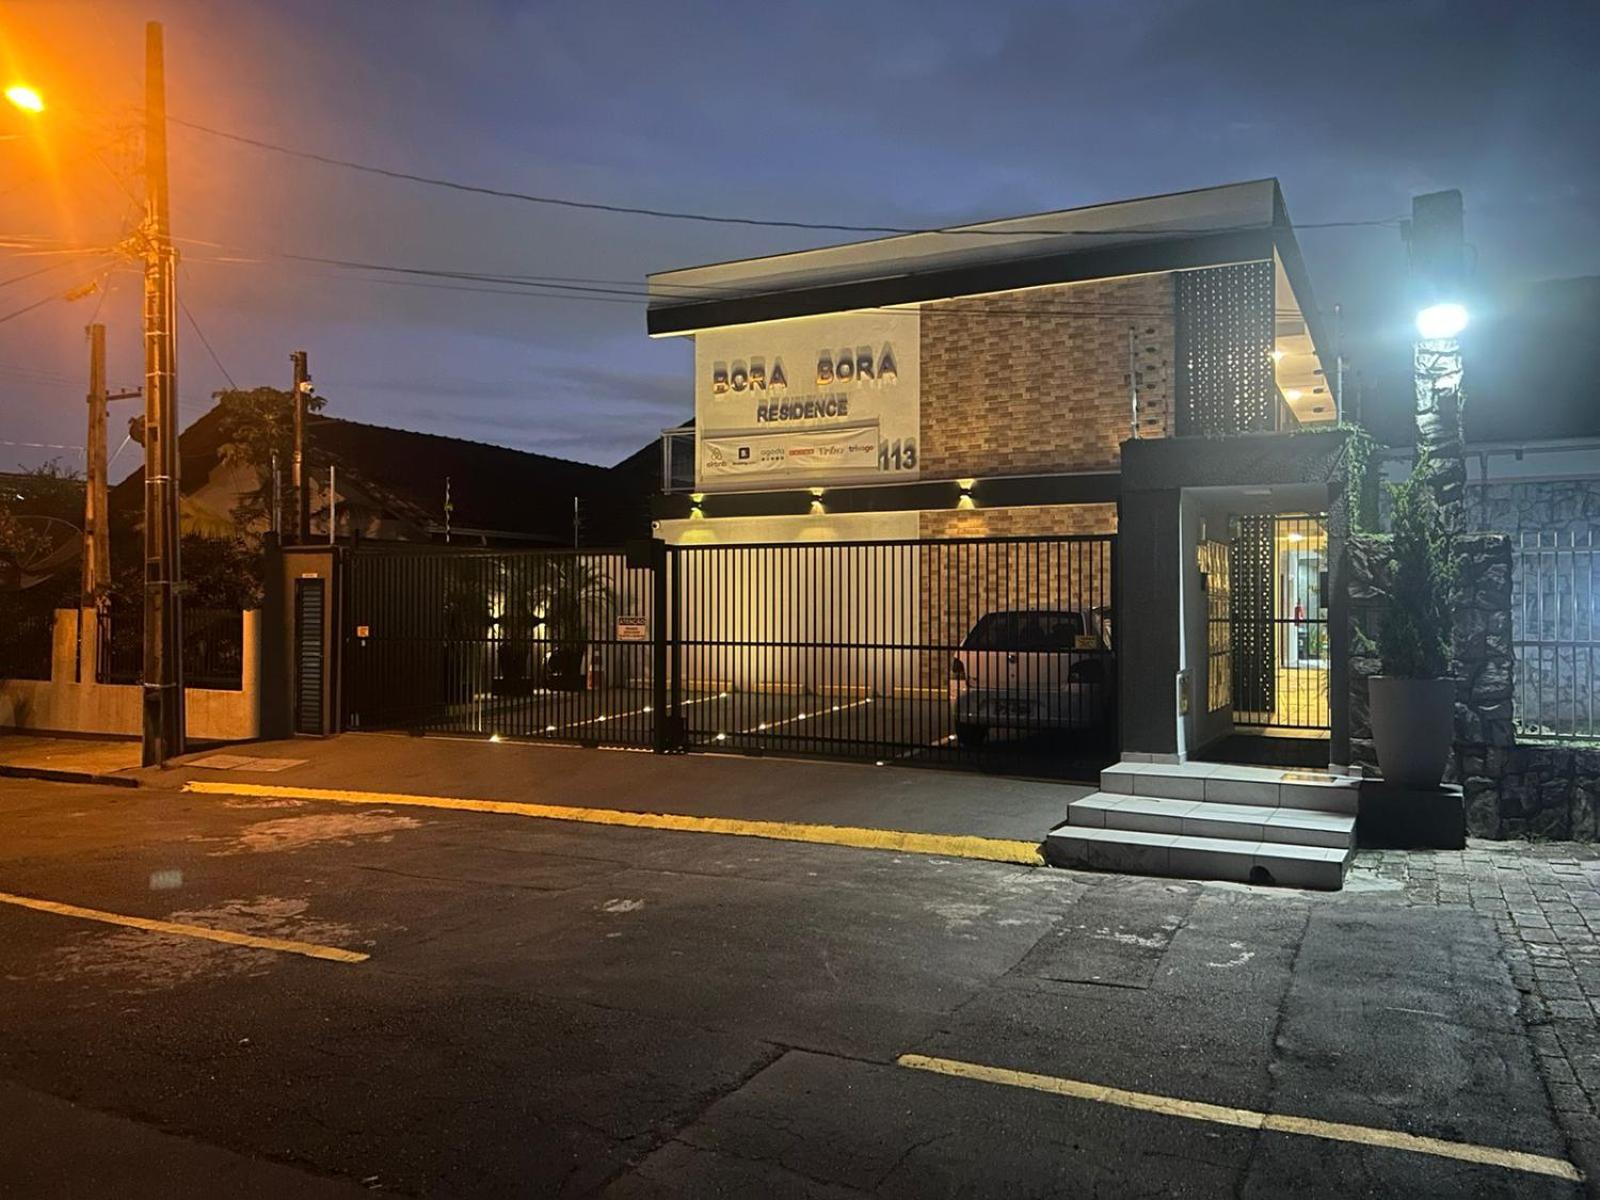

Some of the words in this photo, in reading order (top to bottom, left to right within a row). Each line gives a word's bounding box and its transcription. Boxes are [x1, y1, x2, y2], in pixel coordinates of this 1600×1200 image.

[713, 360, 788, 394] BORA
[816, 348, 898, 386] BORA
[757, 397, 848, 422] RESIDENCE
[878, 441, 917, 471] 113
